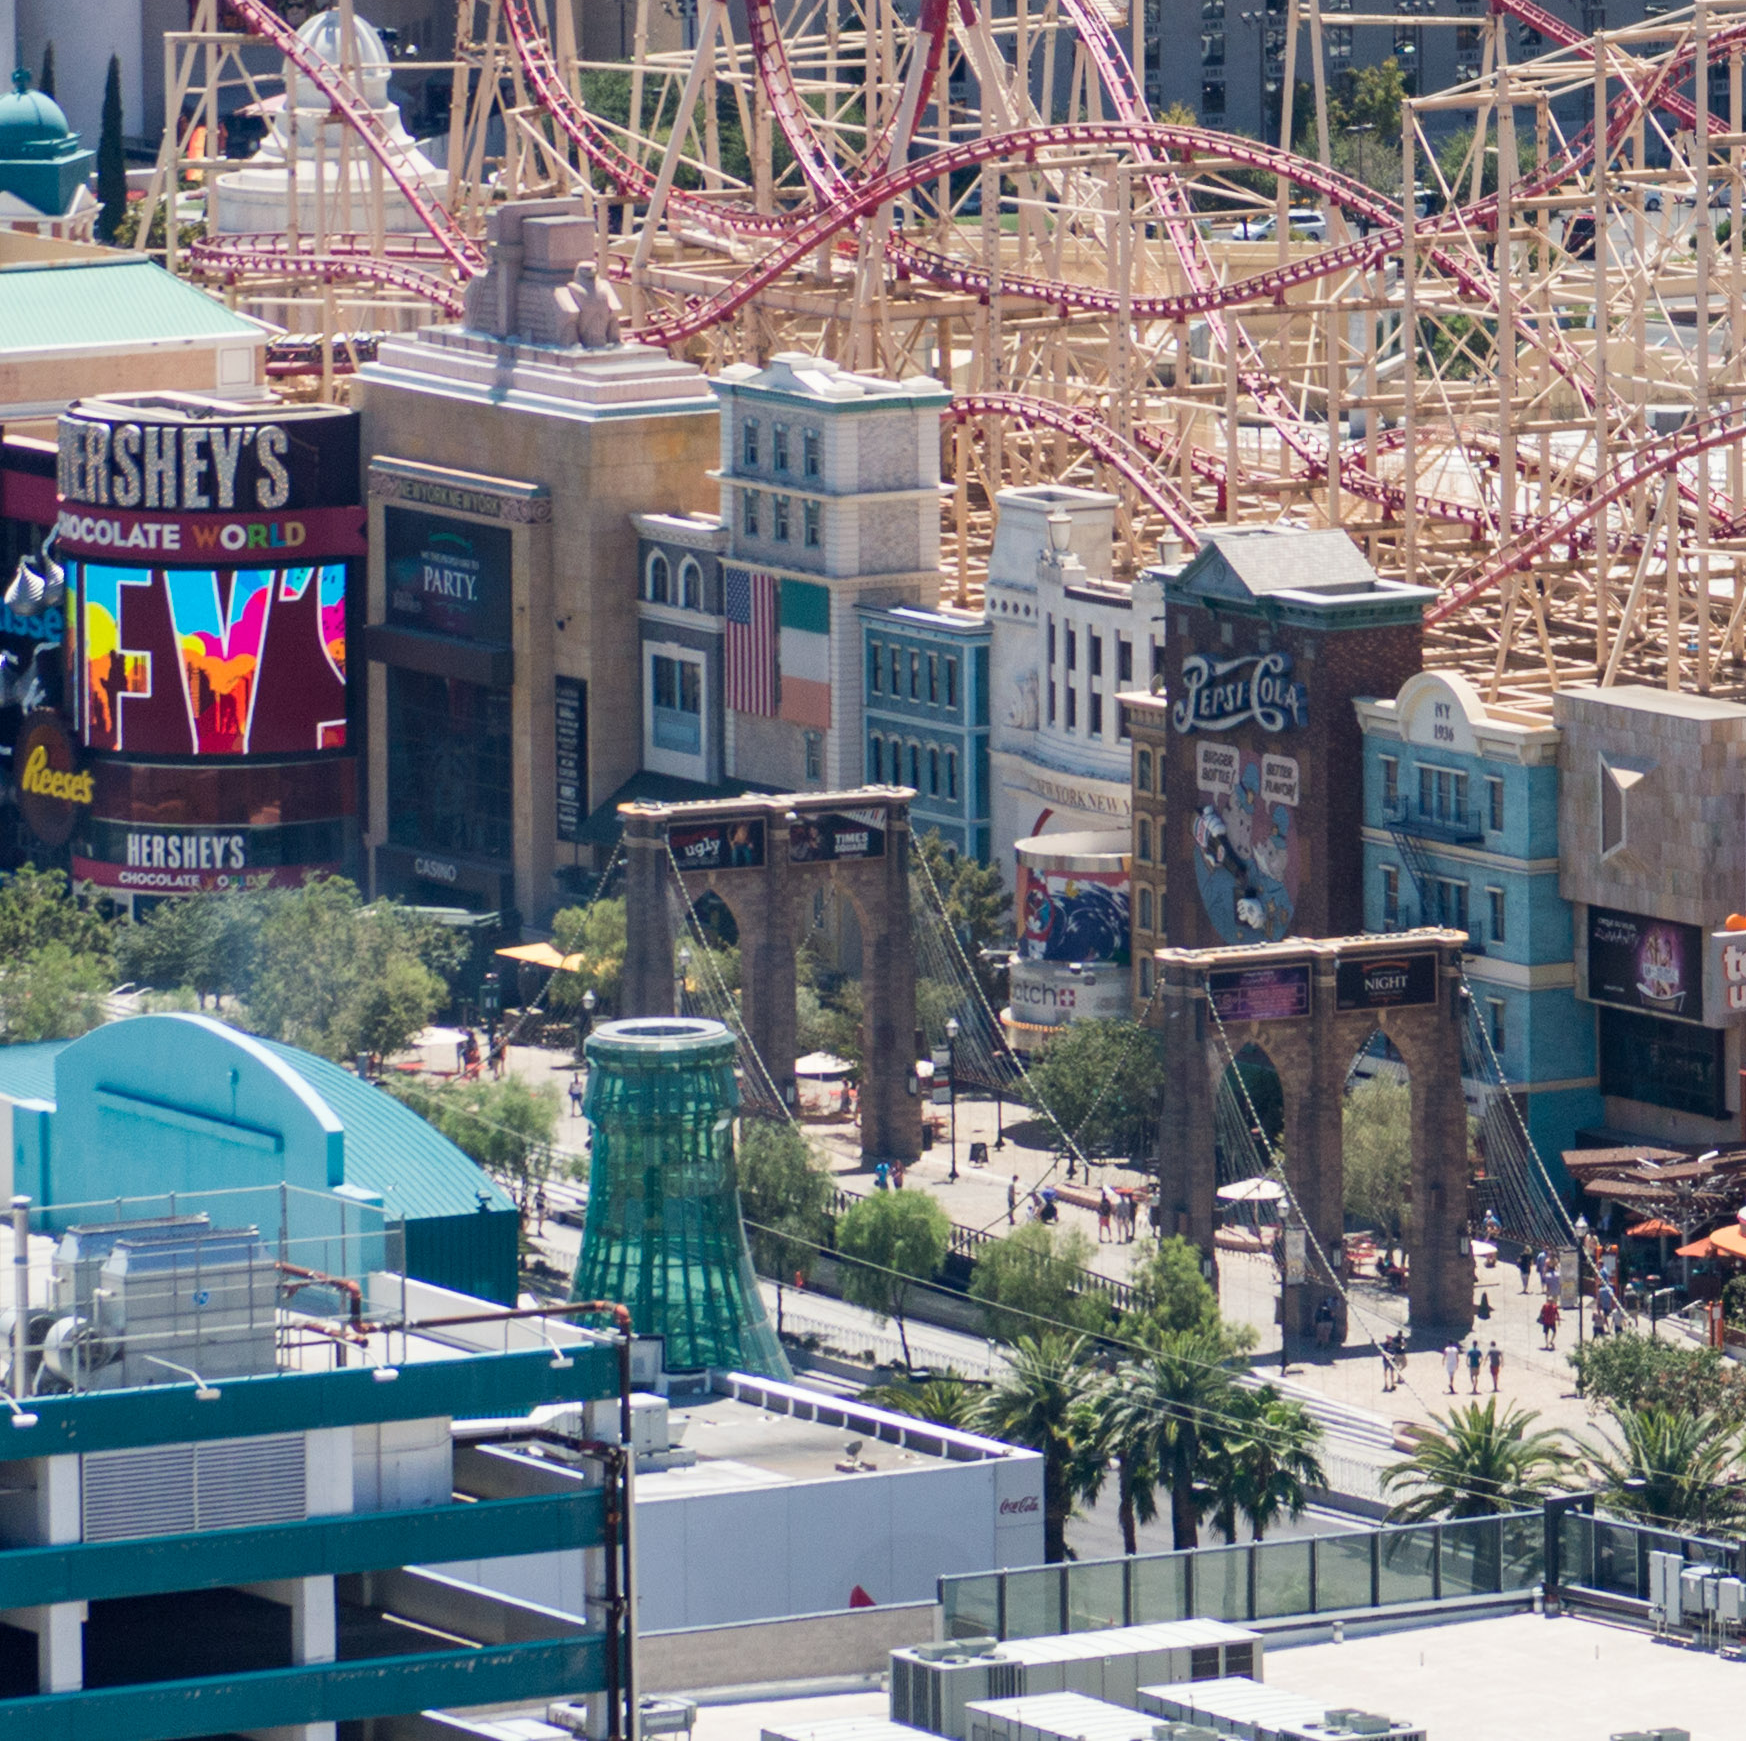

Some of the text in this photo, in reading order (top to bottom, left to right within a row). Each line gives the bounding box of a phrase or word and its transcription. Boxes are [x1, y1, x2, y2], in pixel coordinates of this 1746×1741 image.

[57, 415, 290, 509] HERSHEY'S
[192, 521, 306, 550] WORLD
[1435, 702, 1451, 719] NY
[1265, 762, 1294, 780] BETTER
[1055, 785, 1086, 807] YORK
[1087, 793, 1118, 812] NEW
[684, 837, 721, 858] ugly
[834, 831, 868, 844] TIMES
[127, 833, 245, 870] HERSHEY'S
[118, 871, 200, 887] CHOCOLATE
[415, 857, 456, 882] CASINO
[1013, 983, 1057, 1006] atch
[1364, 975, 1408, 992] NIGHT
